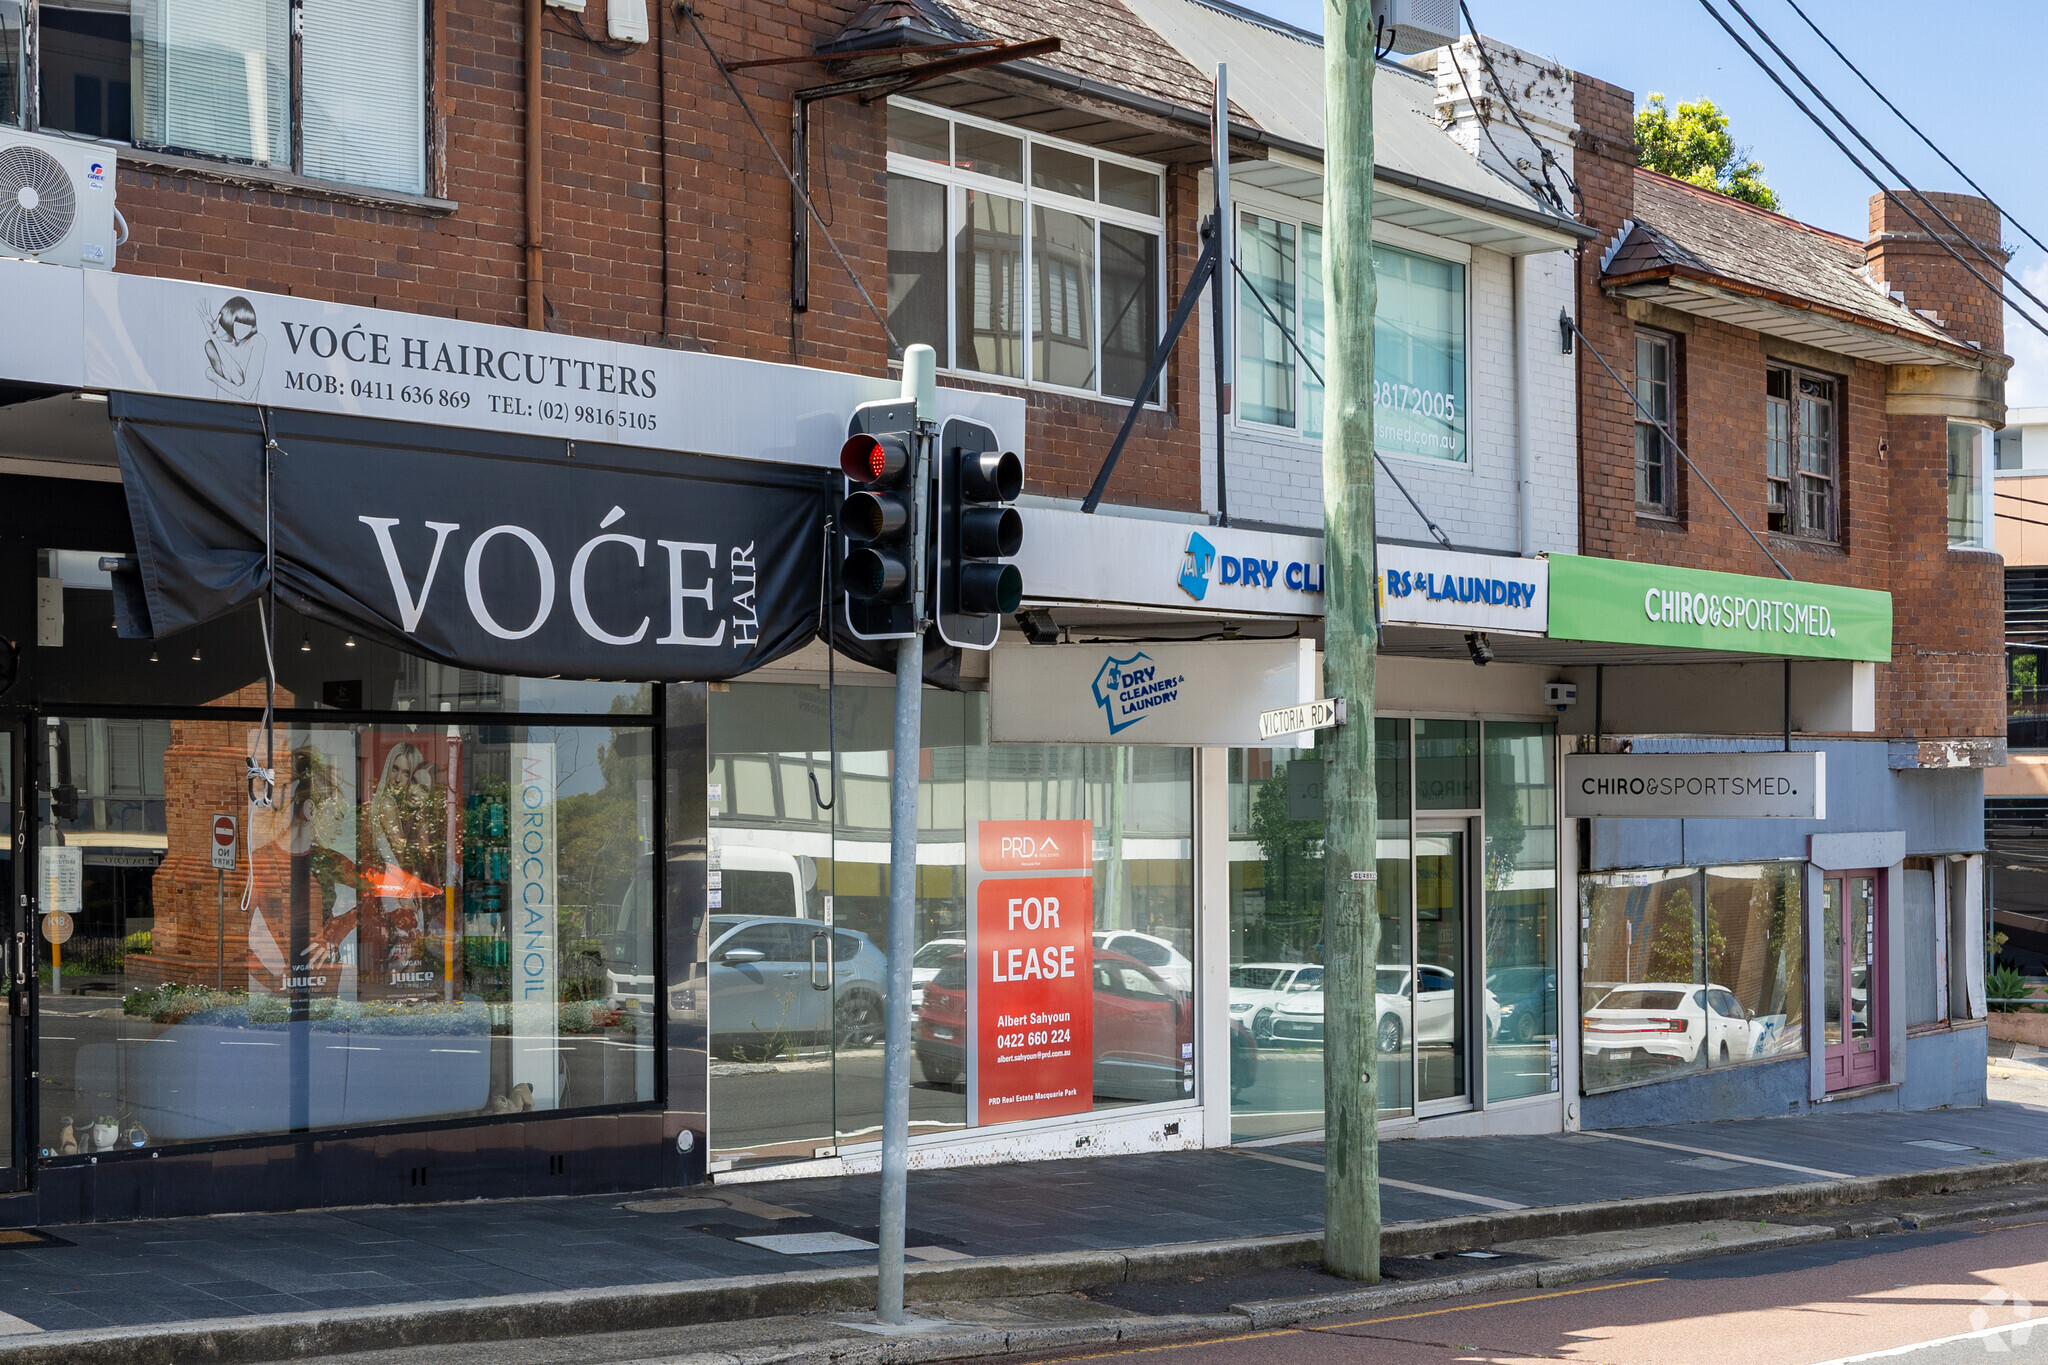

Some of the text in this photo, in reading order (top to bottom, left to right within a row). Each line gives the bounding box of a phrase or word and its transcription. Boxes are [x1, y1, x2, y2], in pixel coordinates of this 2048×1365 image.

[280, 321, 657, 399] VOĆE HAIRCUTTERS
[284, 370, 344, 396] MOB:
[350, 379, 395, 401] 0411
[401, 385, 434, 405] 636
[438, 389, 471, 409] 869
[488, 394, 533, 417] TEL:
[538, 399, 569, 424] (02)
[358, 505, 726, 647] VOĆE
[1219, 555, 1279, 589] DRY
[1414, 571, 1426, 592] &
[1426, 573, 1536, 609] LAUNDRY
[730, 540, 760, 649] HAIR
[1119, 674, 1185, 702] CLEANERS &
[1121, 665, 1156, 689] DRY
[1121, 689, 1178, 715] LAUNDRY
[1263, 704, 1324, 736] VICTORIA RD
[18, 786, 26, 853] 179
[522, 756, 545, 1000] MOROCCANOIL
[47, 916, 66, 927] K18
[1008, 896, 1060, 931] FOR
[389, 968, 434, 986] juuce
[993, 945, 1075, 983] LEASE
[280, 973, 327, 991] juuce
[997, 1012, 1071, 1028] Albert Sahyoun
[997, 1028, 1071, 1049] 0422 660 224
[996, 1049, 1072, 1064] albert.sahyoun@prd.com.au
[988, 1087, 1078, 1106] PRD Real Estate Macquarie Park
